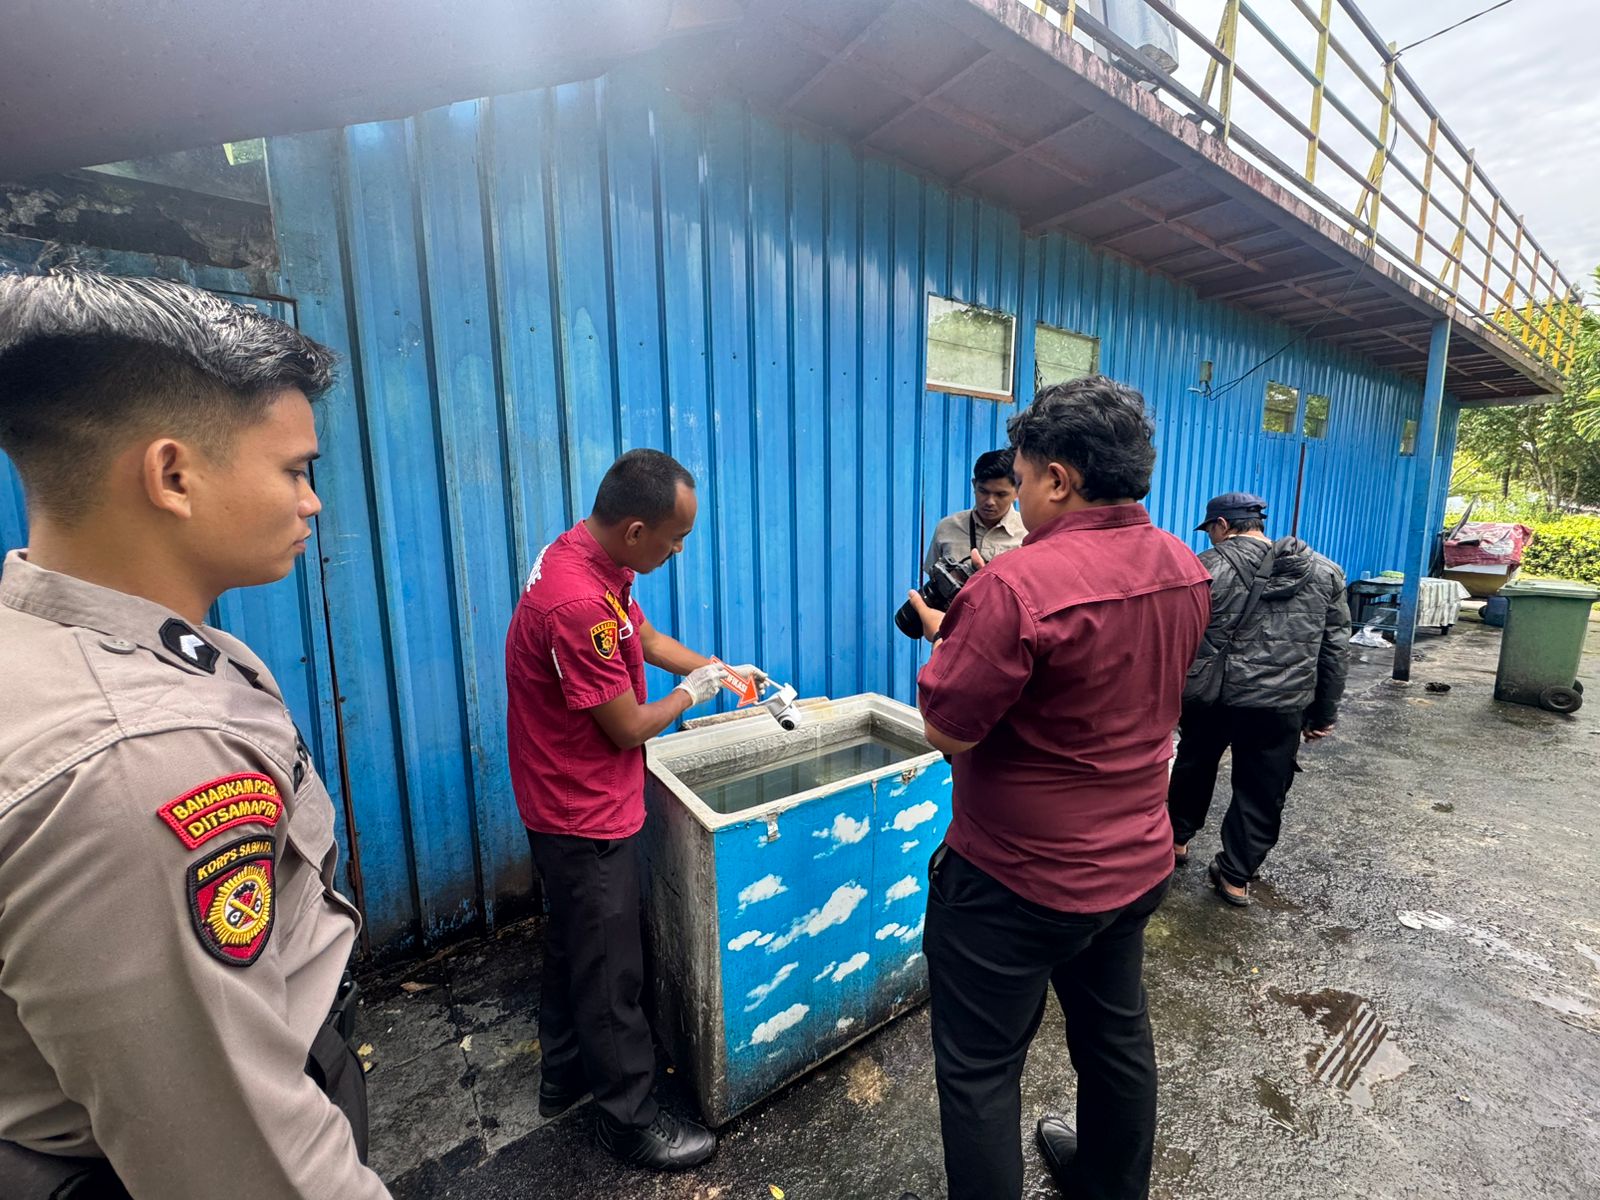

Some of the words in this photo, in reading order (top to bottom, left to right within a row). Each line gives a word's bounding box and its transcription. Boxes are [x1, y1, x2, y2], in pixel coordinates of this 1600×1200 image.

[172, 779, 254, 820] BAHARKAM
[187, 800, 277, 838] DITSAMAPTA
[197, 848, 238, 881] KORPS
